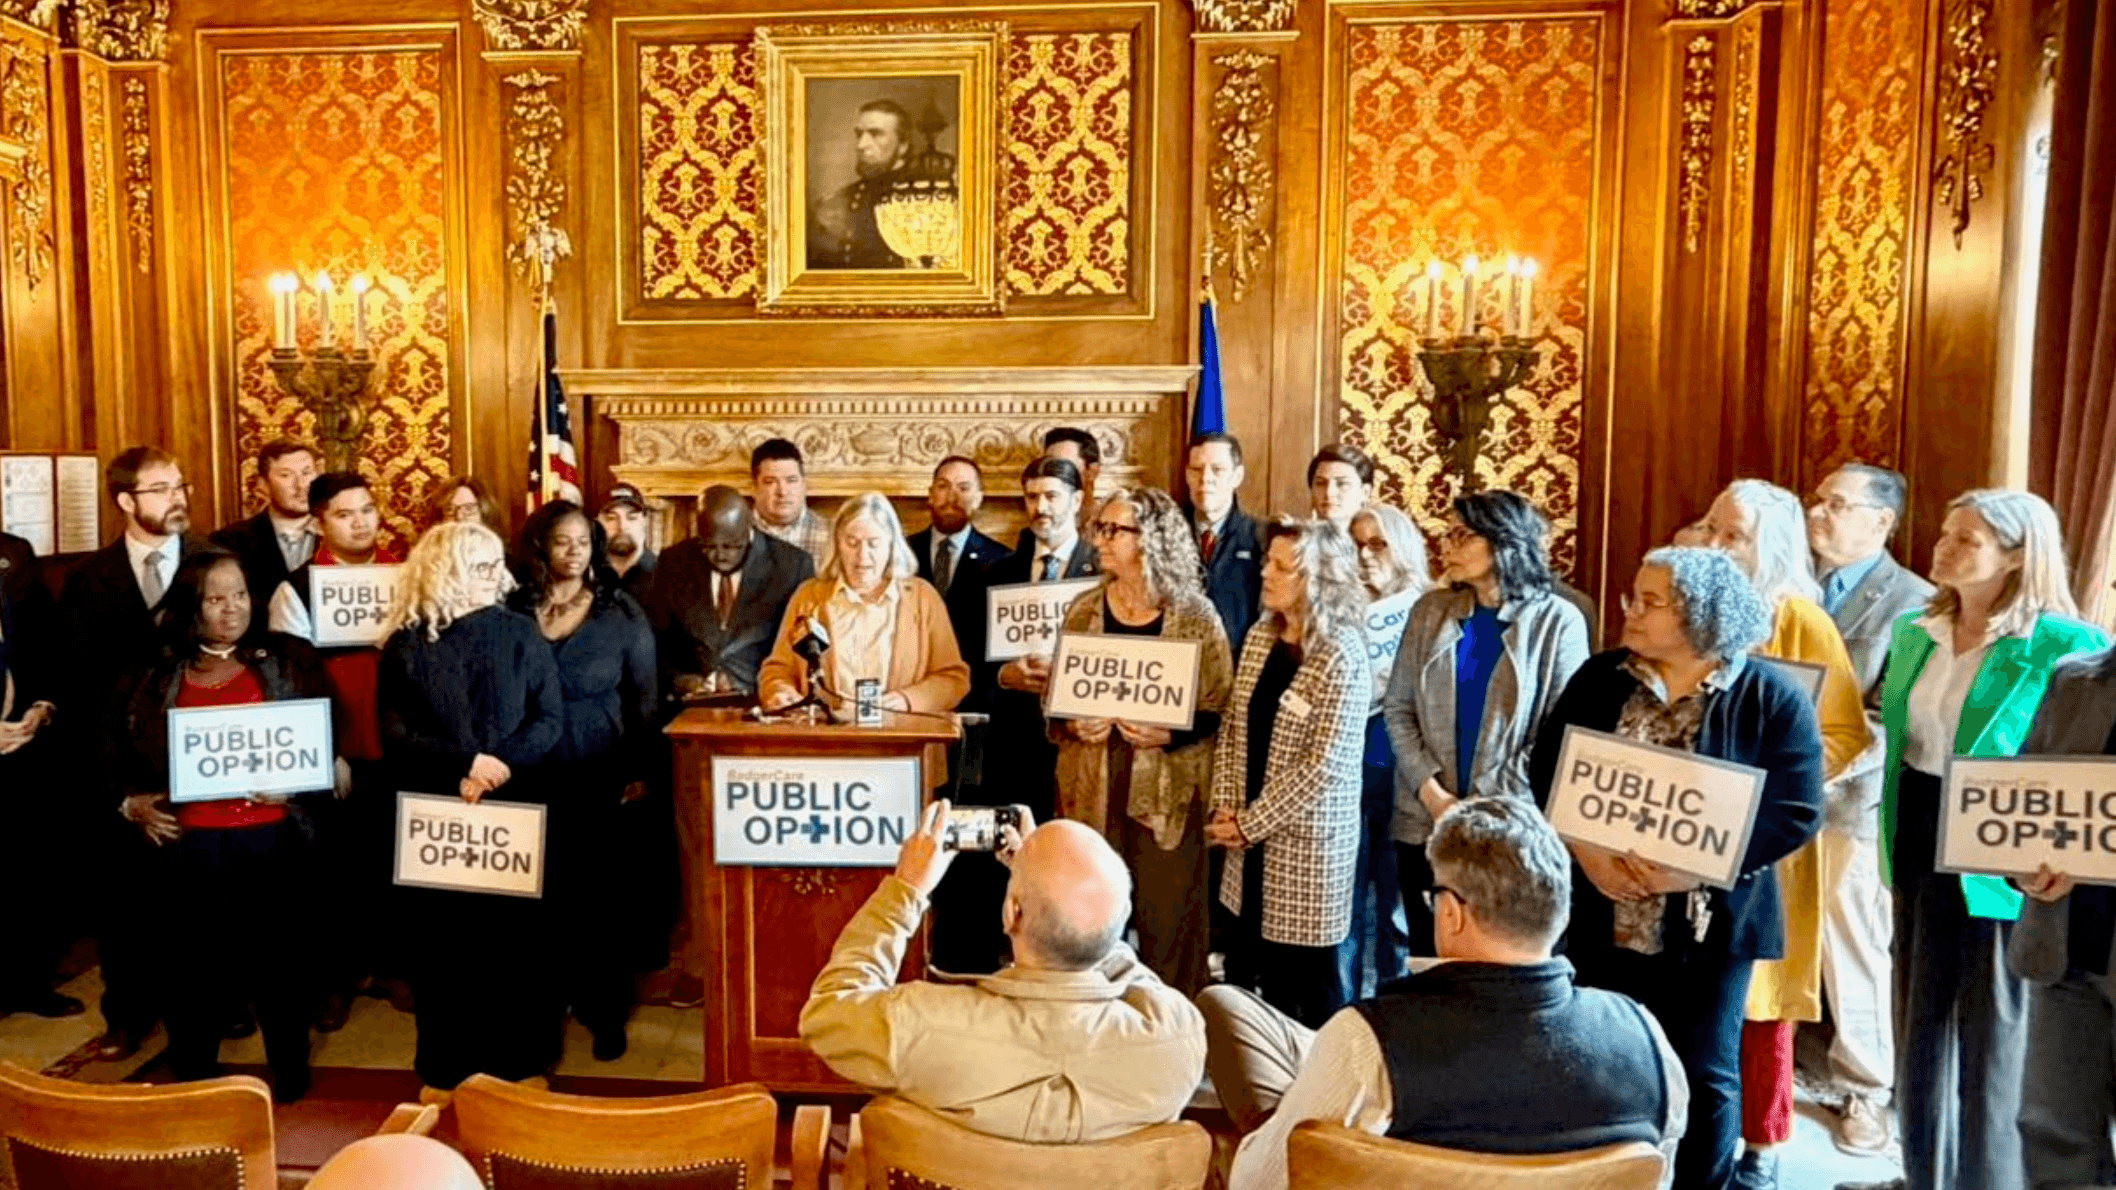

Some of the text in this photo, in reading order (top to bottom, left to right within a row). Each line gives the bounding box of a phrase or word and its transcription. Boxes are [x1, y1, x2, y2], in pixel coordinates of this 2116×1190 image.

[322, 585, 395, 606] PUBLI
[1064, 654, 1164, 682] PUBLIC
[184, 725, 294, 755] PUBLIC
[727, 781, 872, 812] PUBLIC
[1569, 759, 1705, 816] PUBLIC
[409, 818, 511, 848] PUBLIC
